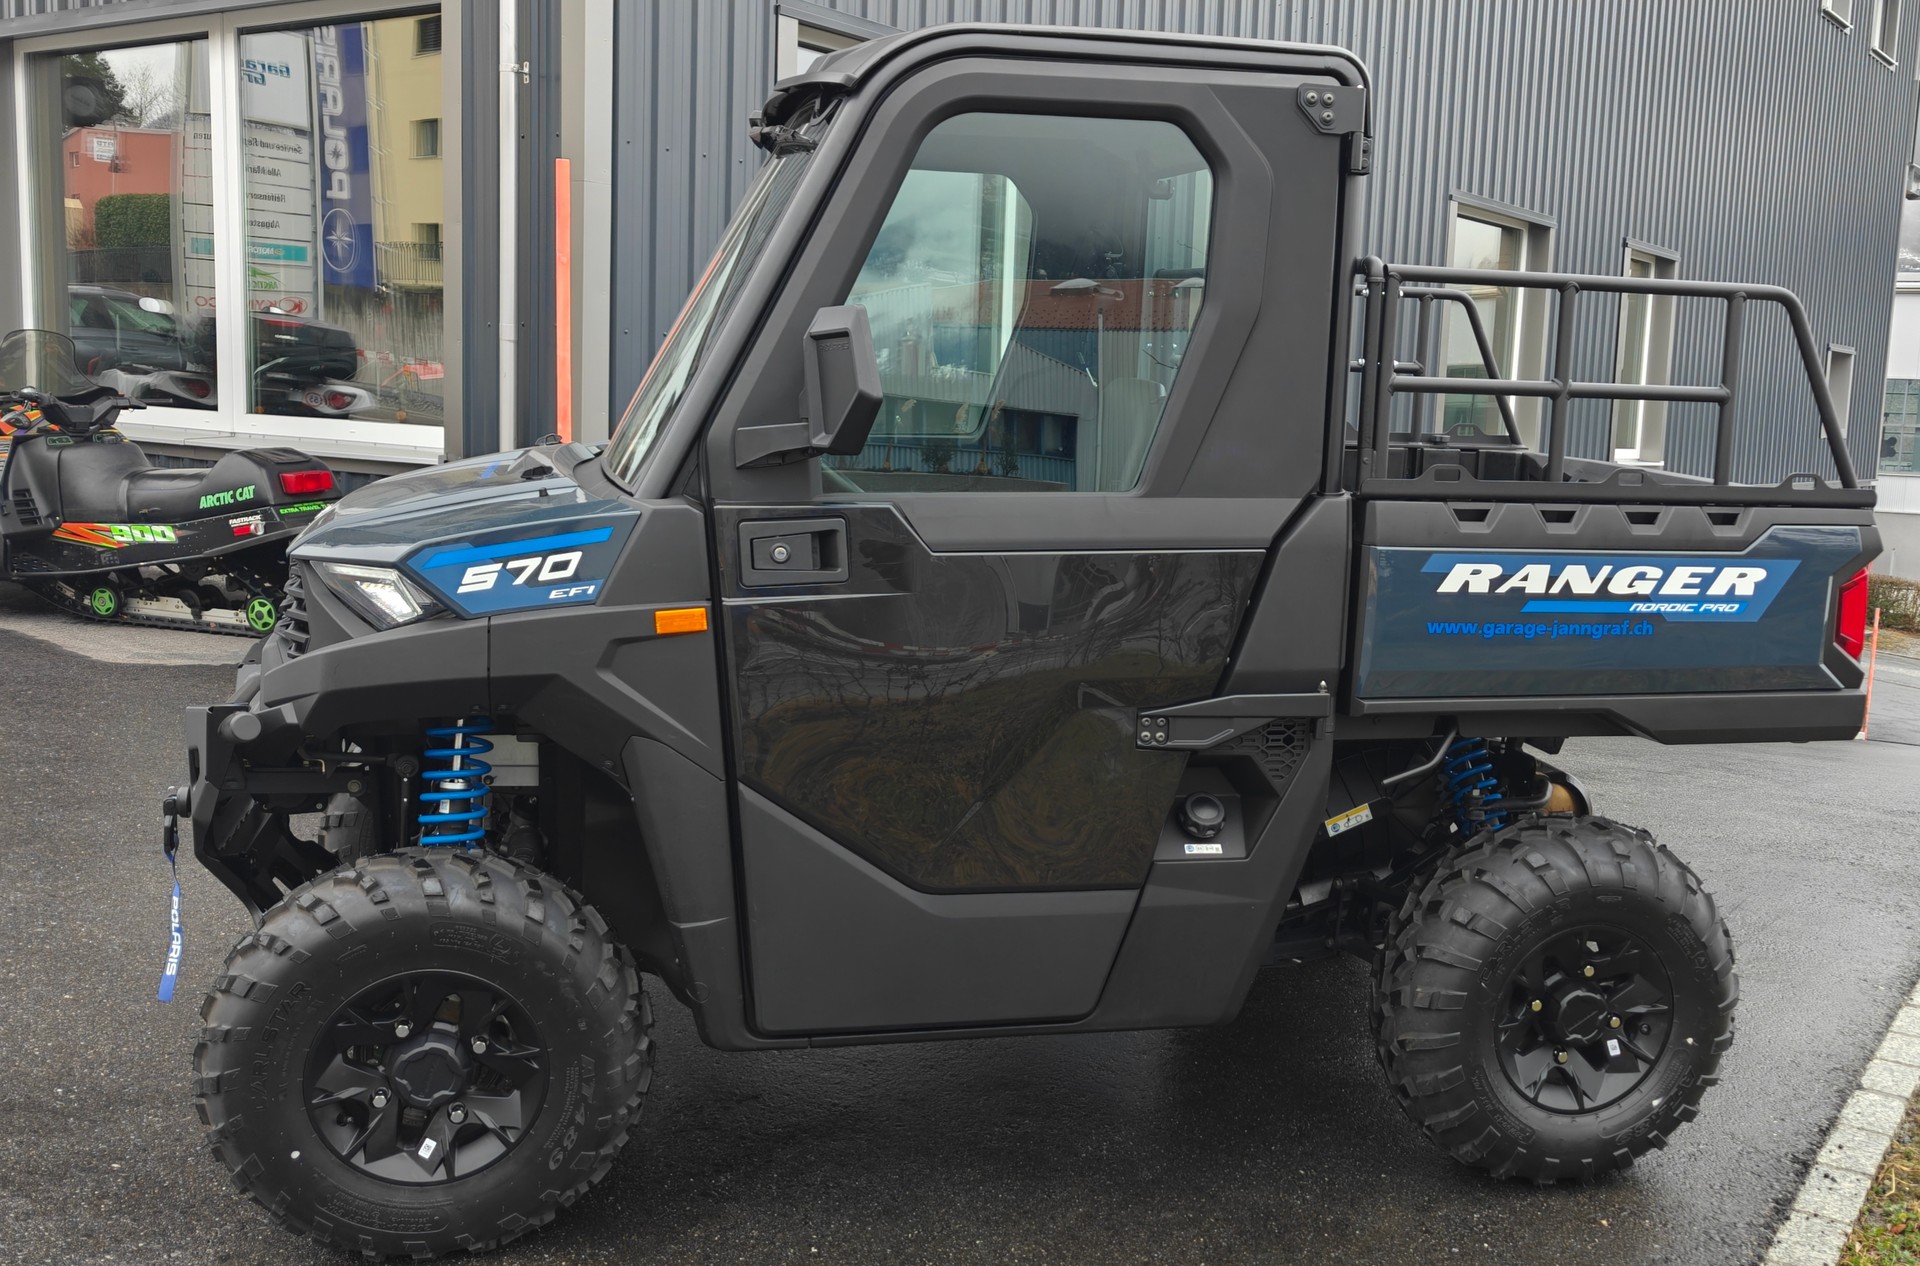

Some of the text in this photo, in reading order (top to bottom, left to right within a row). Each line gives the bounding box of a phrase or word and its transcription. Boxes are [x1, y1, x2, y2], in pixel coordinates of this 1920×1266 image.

[199, 485, 256, 510] ARCTIC CAT
[279, 507, 300, 515] EXTRA
[300, 504, 320, 513] TRAVEL
[229, 514, 262, 525] FASTRACK
[110, 525, 177, 543] 900
[456, 551, 583, 594] 570
[1437, 563, 1767, 596] RANGER
[549, 585, 596, 599] EFI
[1629, 603, 1740, 613] NORDIC PRO
[1427, 619, 1654, 640] www.garage-janngraf.ch
[165, 895, 183, 976] POLARIS
